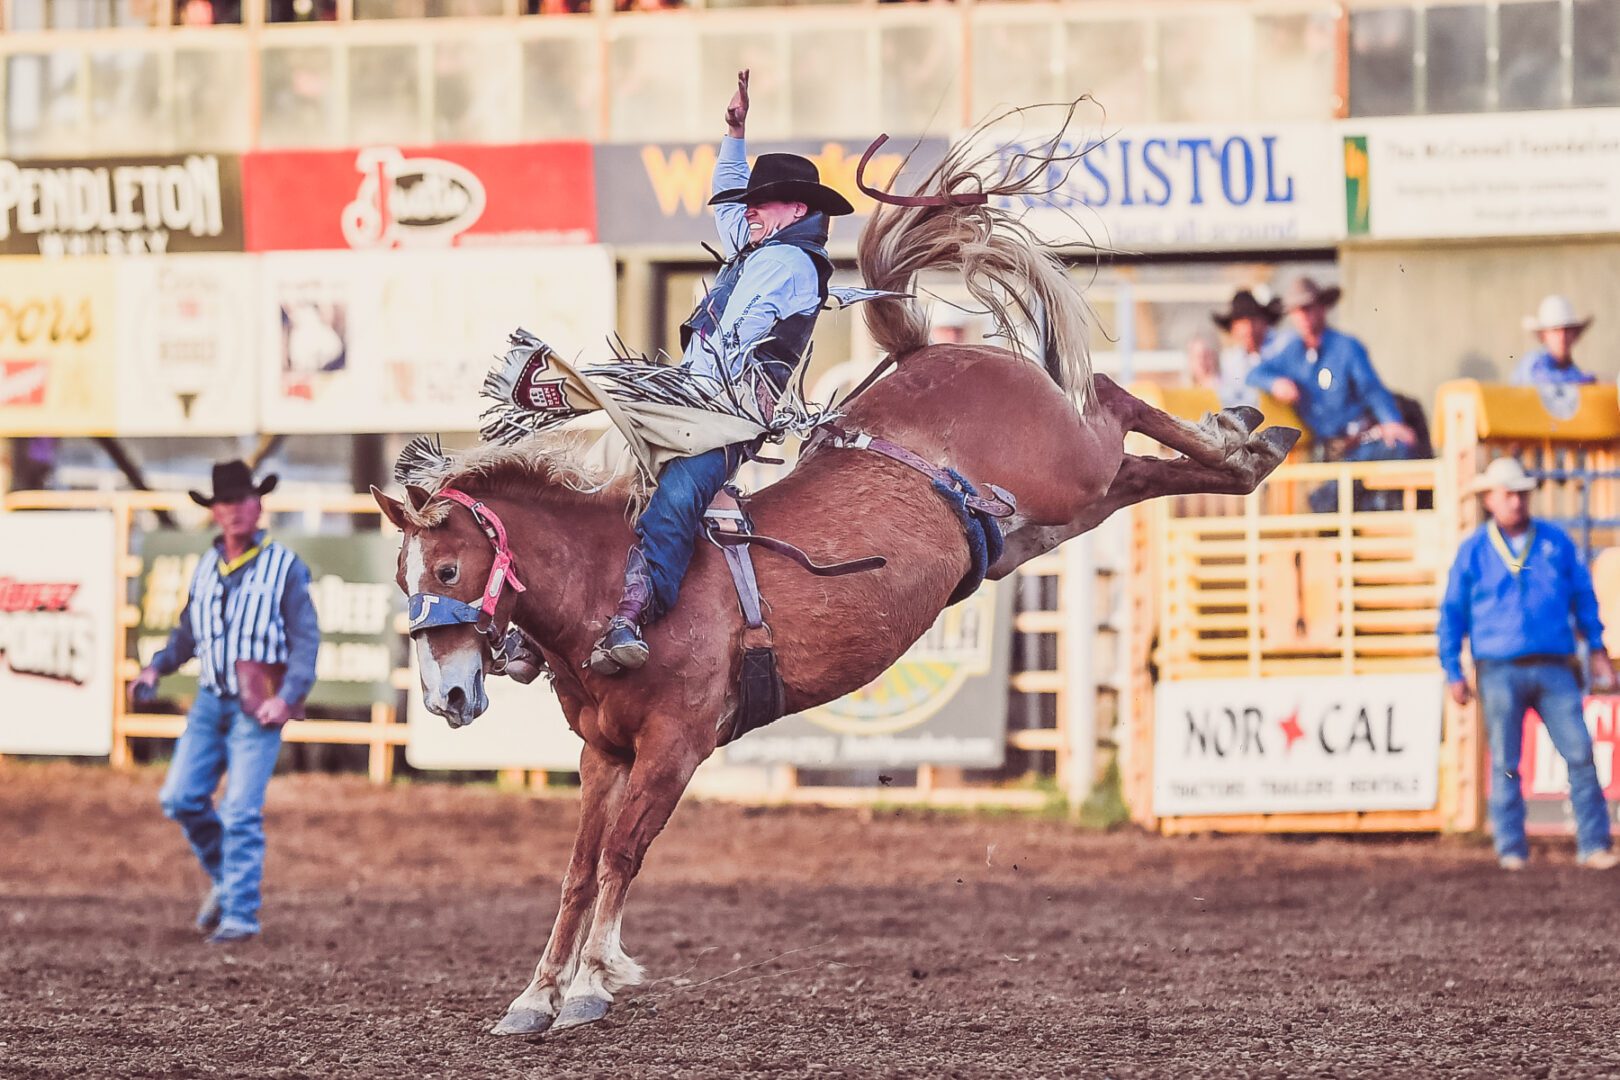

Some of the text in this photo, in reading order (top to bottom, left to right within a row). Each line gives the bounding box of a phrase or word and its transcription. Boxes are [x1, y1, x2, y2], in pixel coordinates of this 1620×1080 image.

[0, 157, 222, 241] PENDLETON
[995, 135, 1296, 208] RESISTOL
[0, 296, 92, 344] oors
[1185, 703, 1405, 757] NOR CAL
